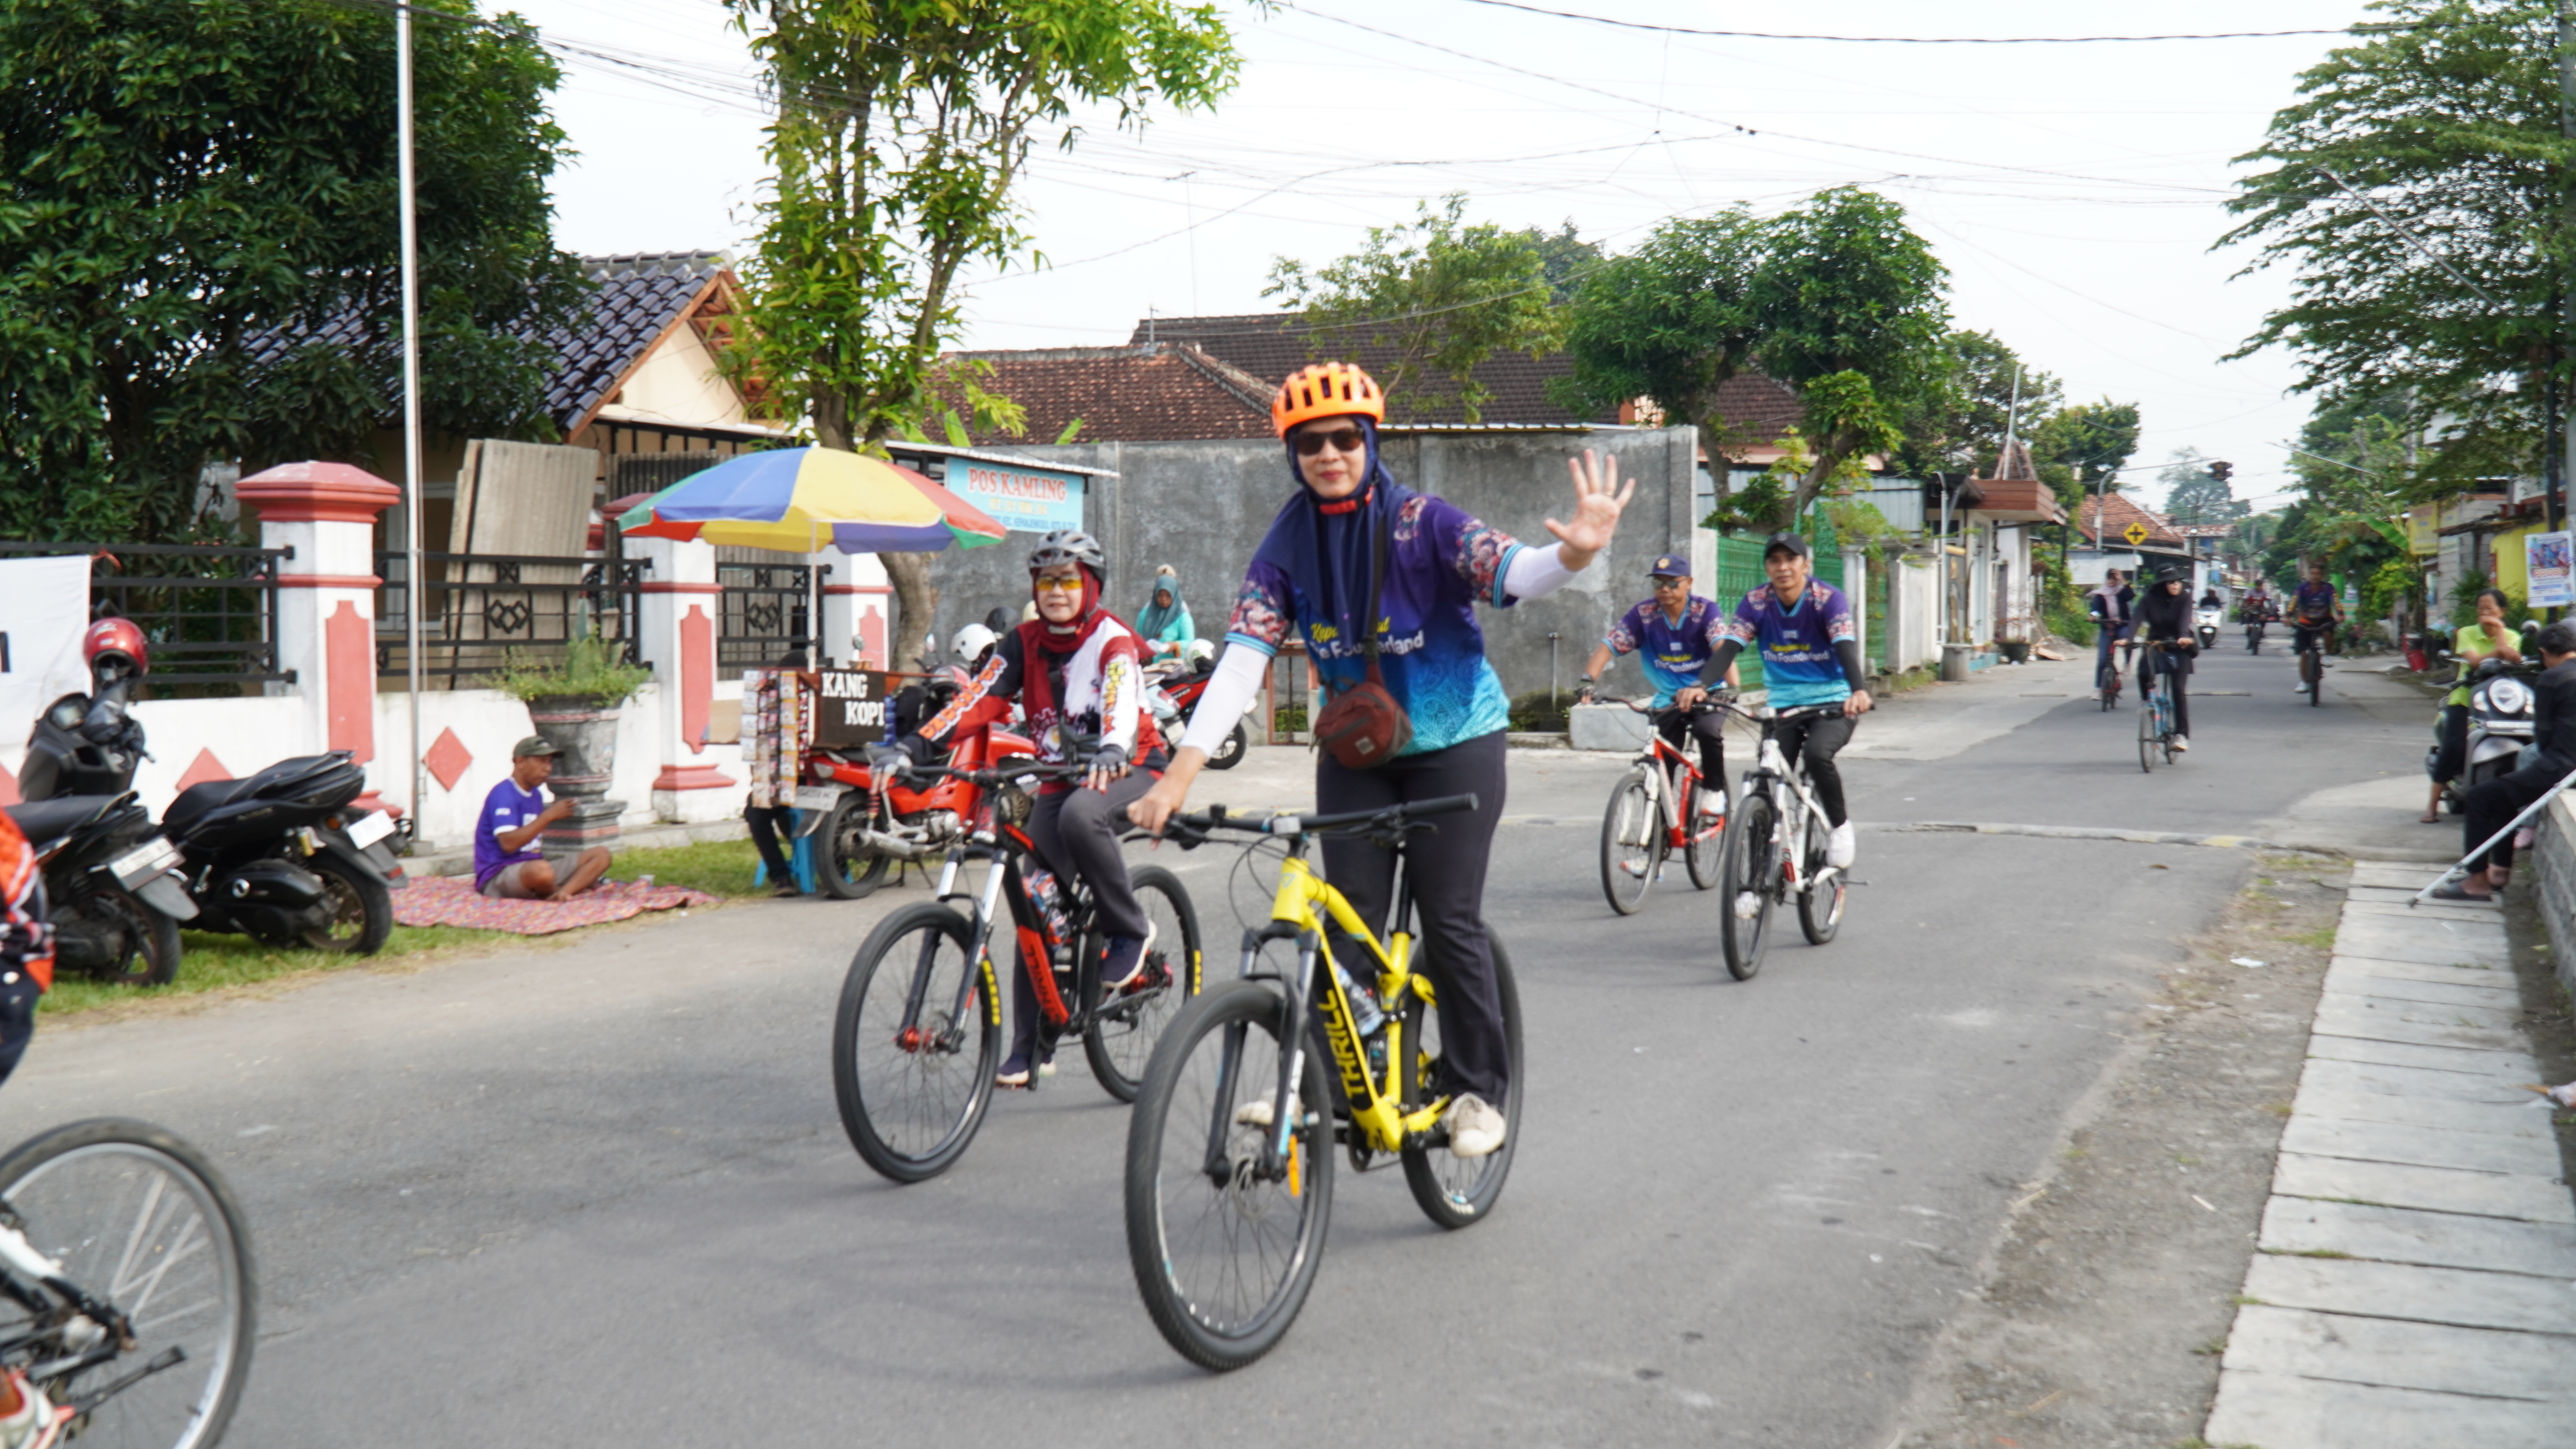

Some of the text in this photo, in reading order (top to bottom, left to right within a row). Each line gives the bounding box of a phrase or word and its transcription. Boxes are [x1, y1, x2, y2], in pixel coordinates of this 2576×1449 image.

[969, 468, 1066, 501] POS KAMLING
[821, 672, 868, 698] KANG
[845, 700, 885, 726] KOPI
[1317, 988, 1365, 1099] THRILL
